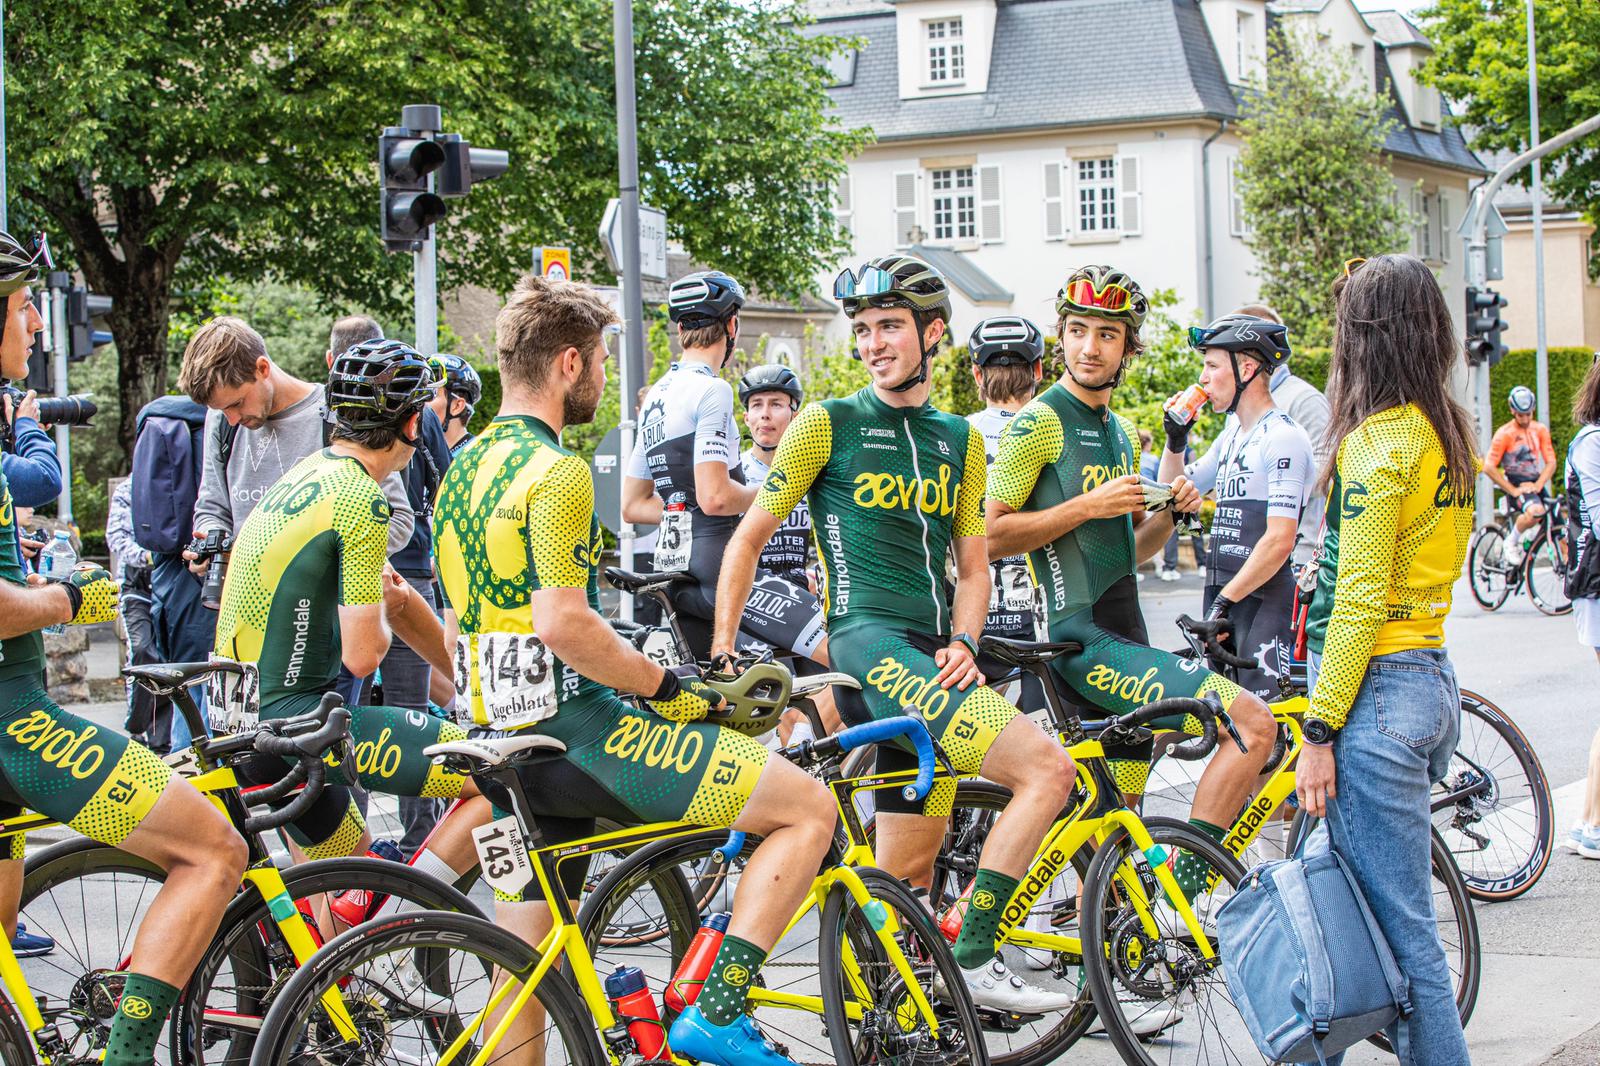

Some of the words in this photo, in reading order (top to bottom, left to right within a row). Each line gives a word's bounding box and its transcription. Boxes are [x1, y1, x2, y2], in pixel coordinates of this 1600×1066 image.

[642, 421, 667, 450] ABLOC
[862, 443, 898, 451] SHIMANO
[824, 513, 851, 616] cannondale
[752, 617, 768, 627] ZERO
[1388, 610, 1412, 619] utt'r
[284, 598, 311, 688] cannondale
[484, 636, 548, 692] 143
[489, 694, 549, 722] Tageblatt
[954, 720, 979, 740] 13
[712, 759, 741, 786] 13
[107, 779, 138, 805] 13
[478, 827, 515, 879] 143
[338, 934, 366, 952] CORSA
